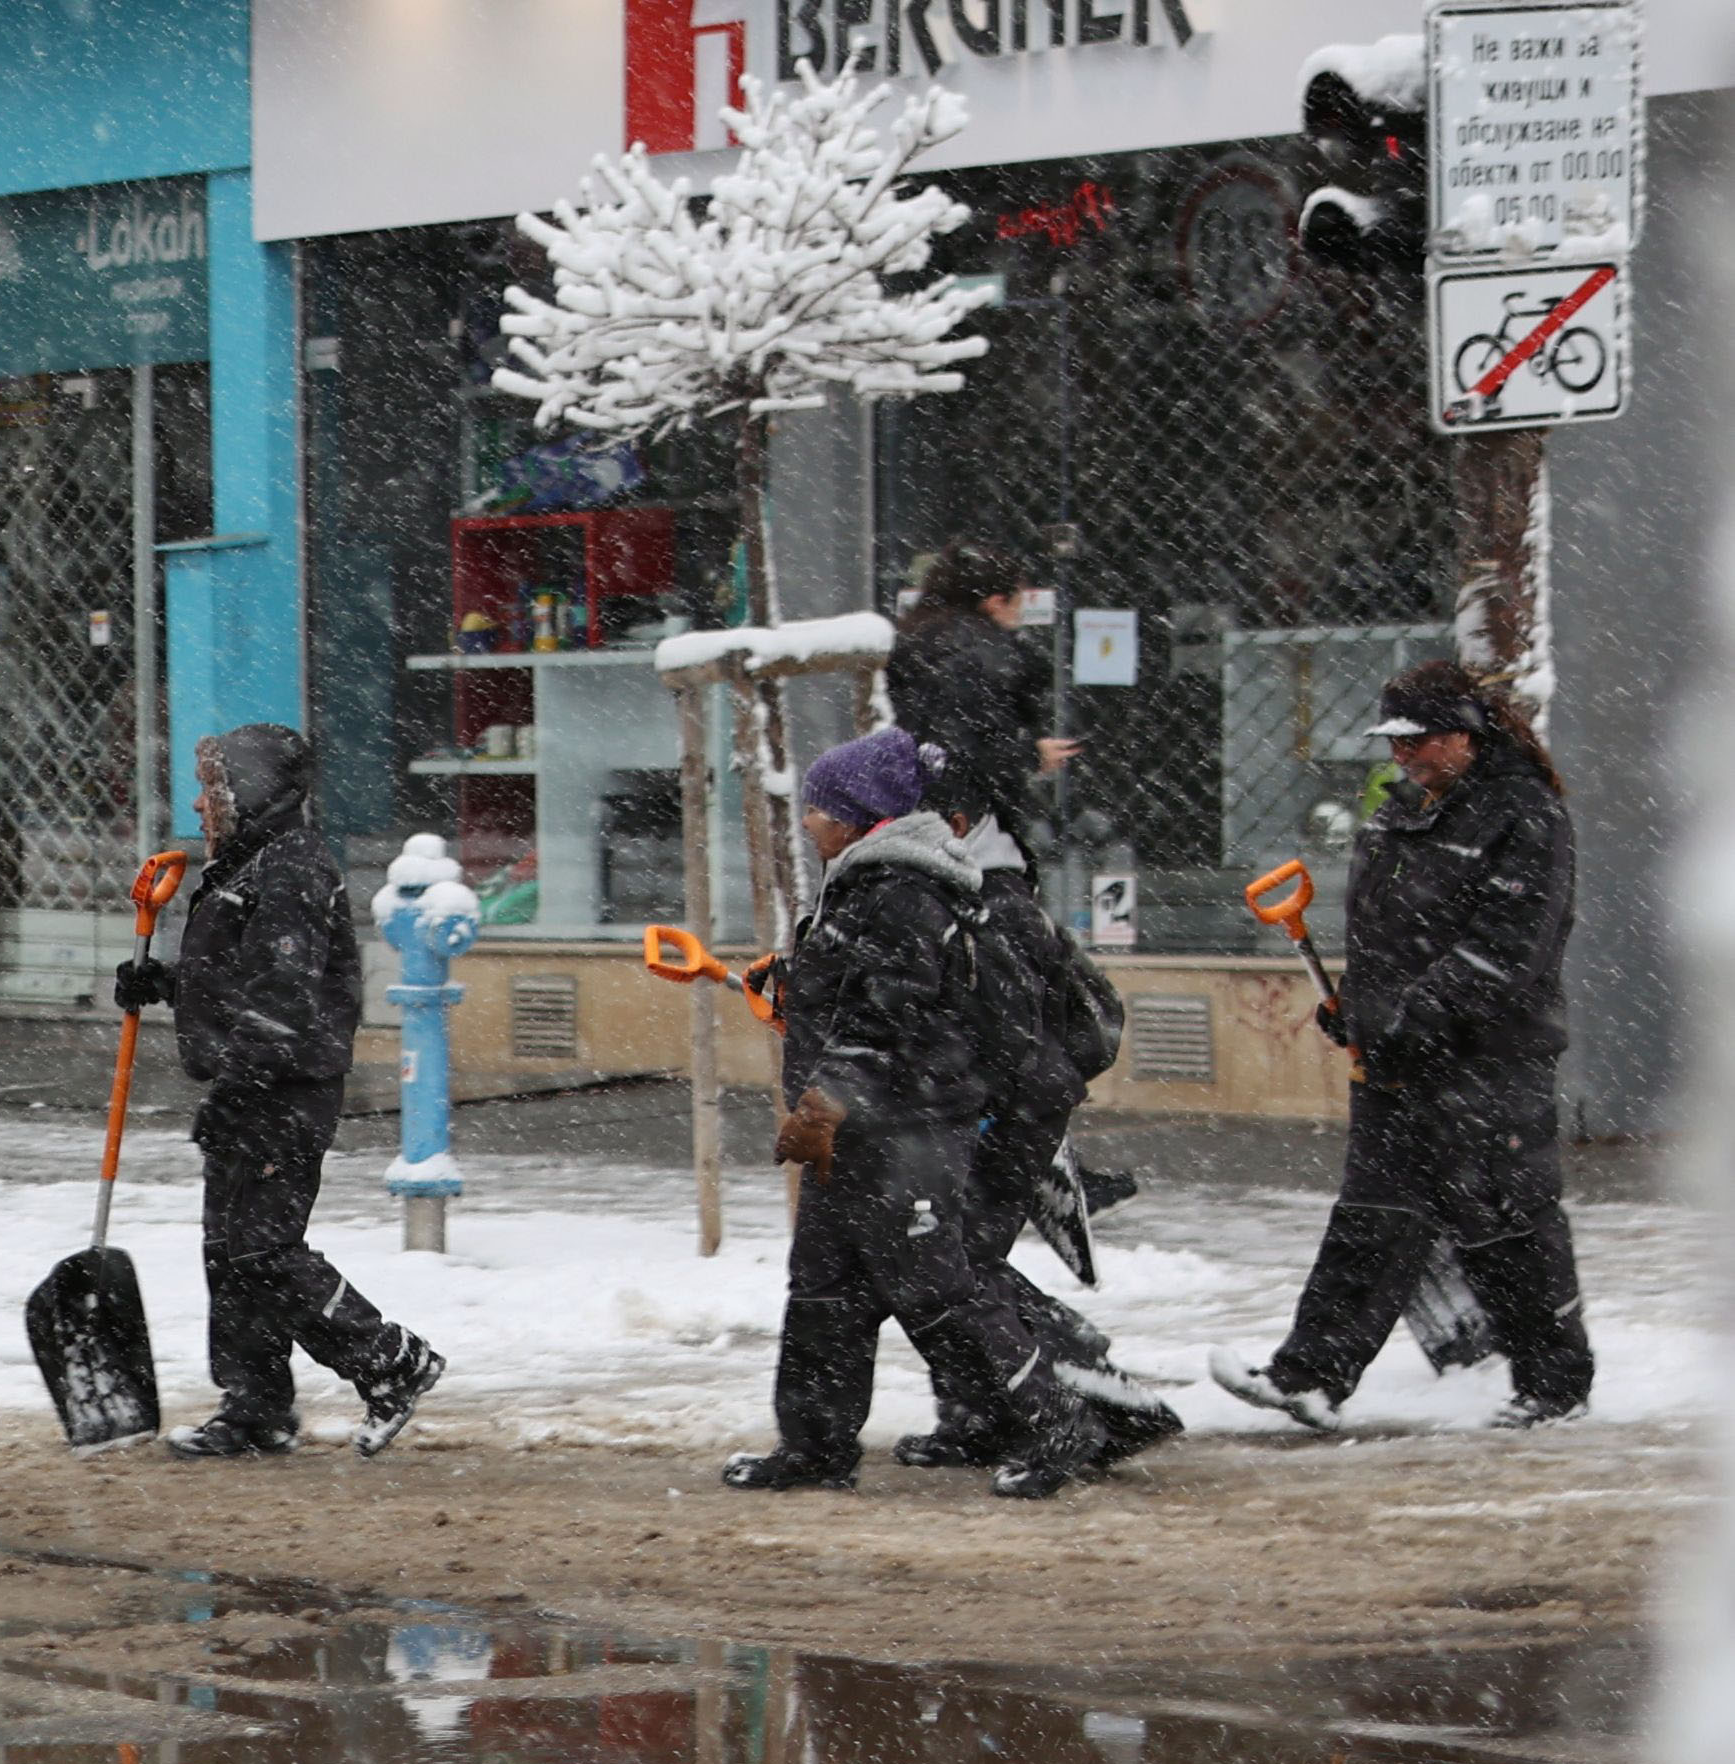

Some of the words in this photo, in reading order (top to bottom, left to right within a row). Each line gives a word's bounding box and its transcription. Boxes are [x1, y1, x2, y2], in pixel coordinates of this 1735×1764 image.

[1472, 34, 1499, 63] Не
[1510, 37, 1565, 62] важи
[1456, 115, 1582, 152] обслужване
[1448, 157, 1520, 189] обекти
[1532, 160, 1553, 184] от
[1494, 194, 1555, 228] 0500
